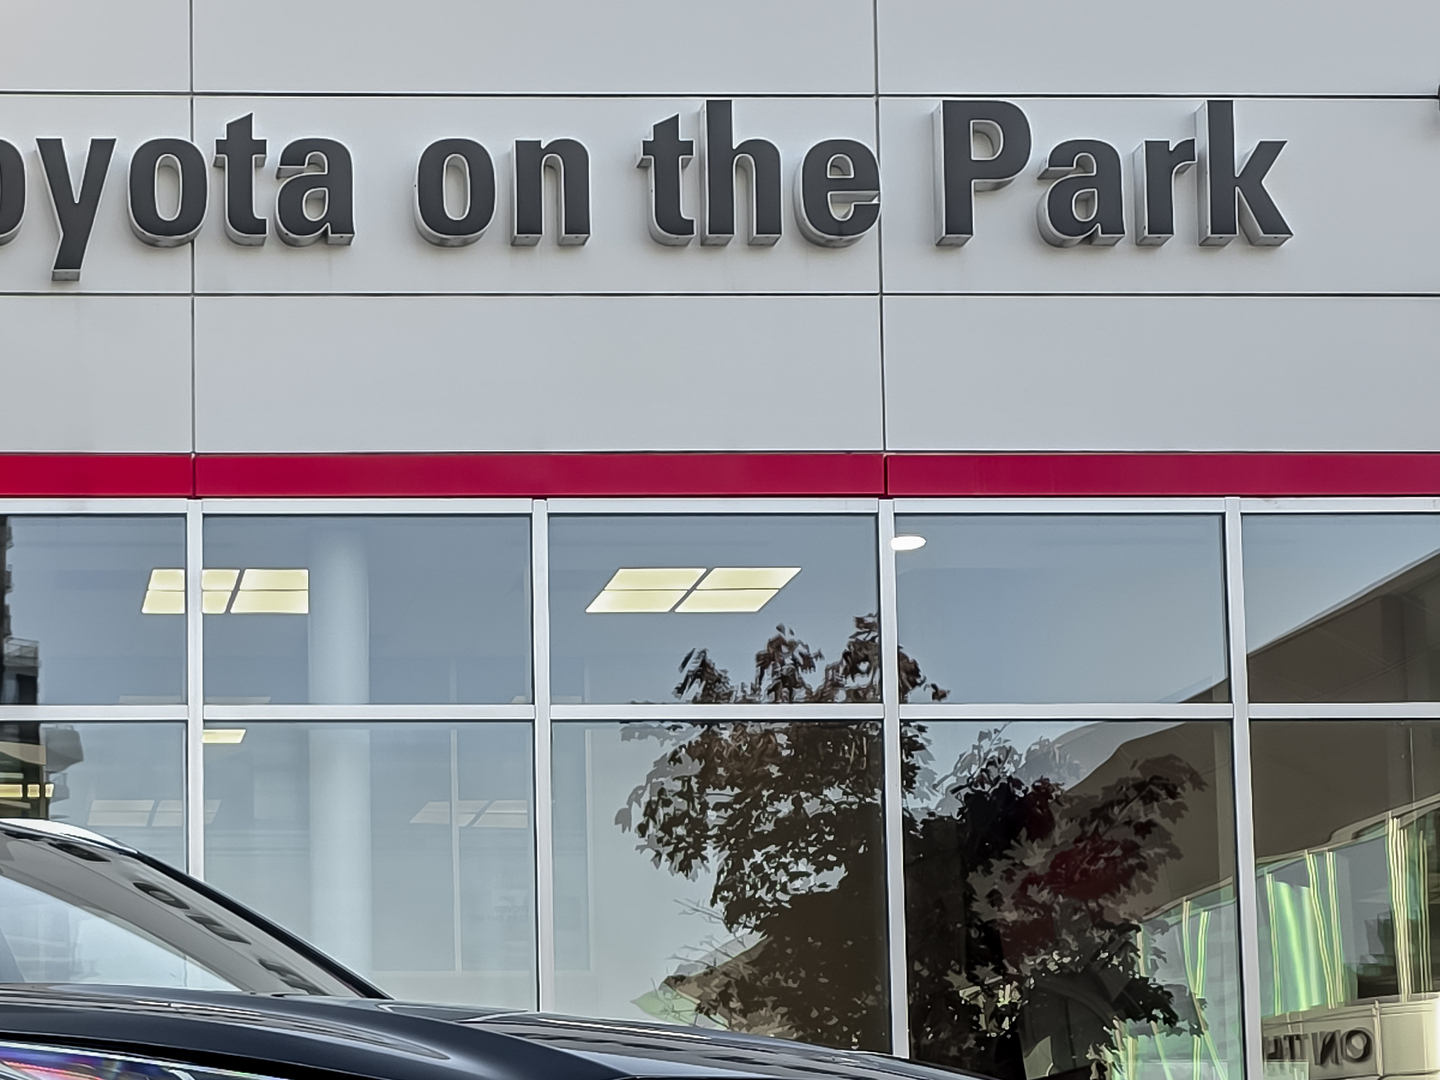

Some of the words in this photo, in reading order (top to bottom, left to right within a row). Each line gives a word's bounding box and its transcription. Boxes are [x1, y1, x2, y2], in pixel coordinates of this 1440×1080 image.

[413, 136, 589, 247] on
[636, 99, 881, 248] the
[932, 99, 1293, 248] Park
